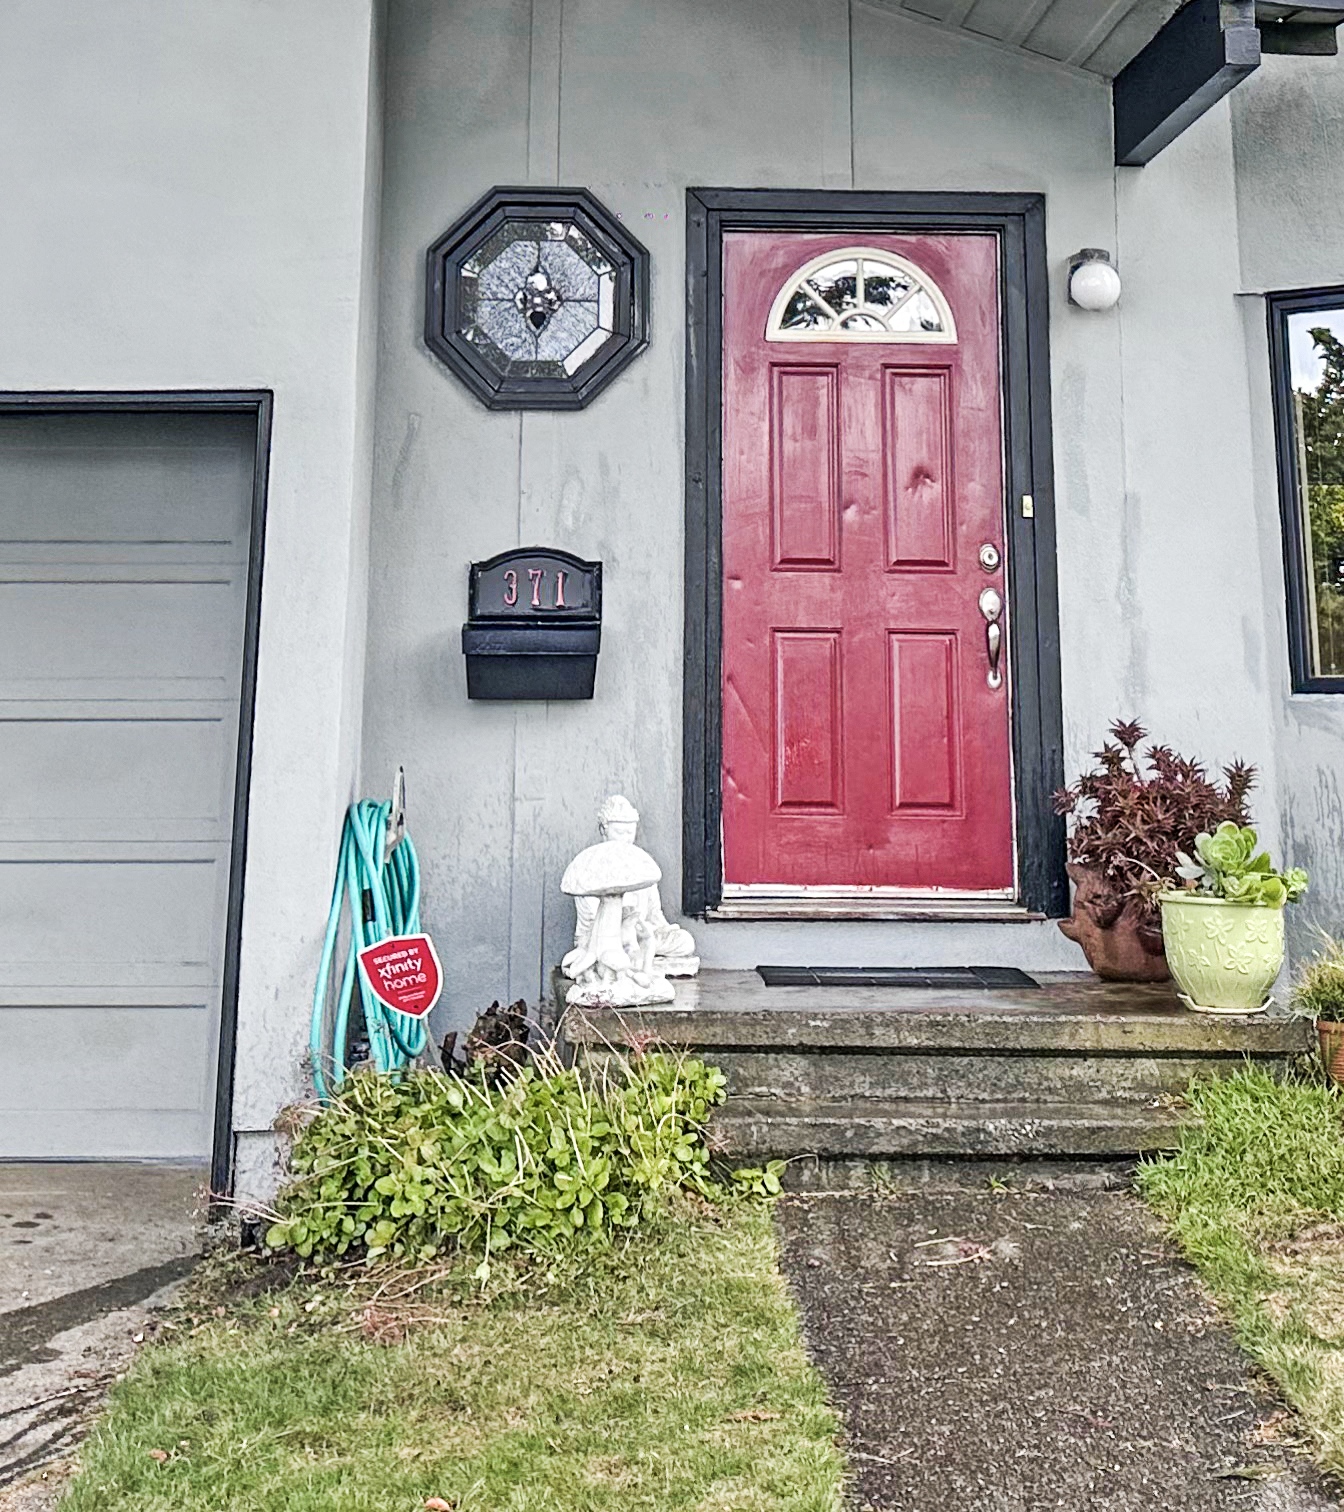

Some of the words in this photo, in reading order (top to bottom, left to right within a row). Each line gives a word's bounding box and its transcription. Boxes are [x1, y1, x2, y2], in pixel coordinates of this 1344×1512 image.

[503, 569, 566, 607] 371
[373, 950, 408, 965] SECURED
[377, 958, 422, 979] xfinity
[383, 973, 427, 991] home
